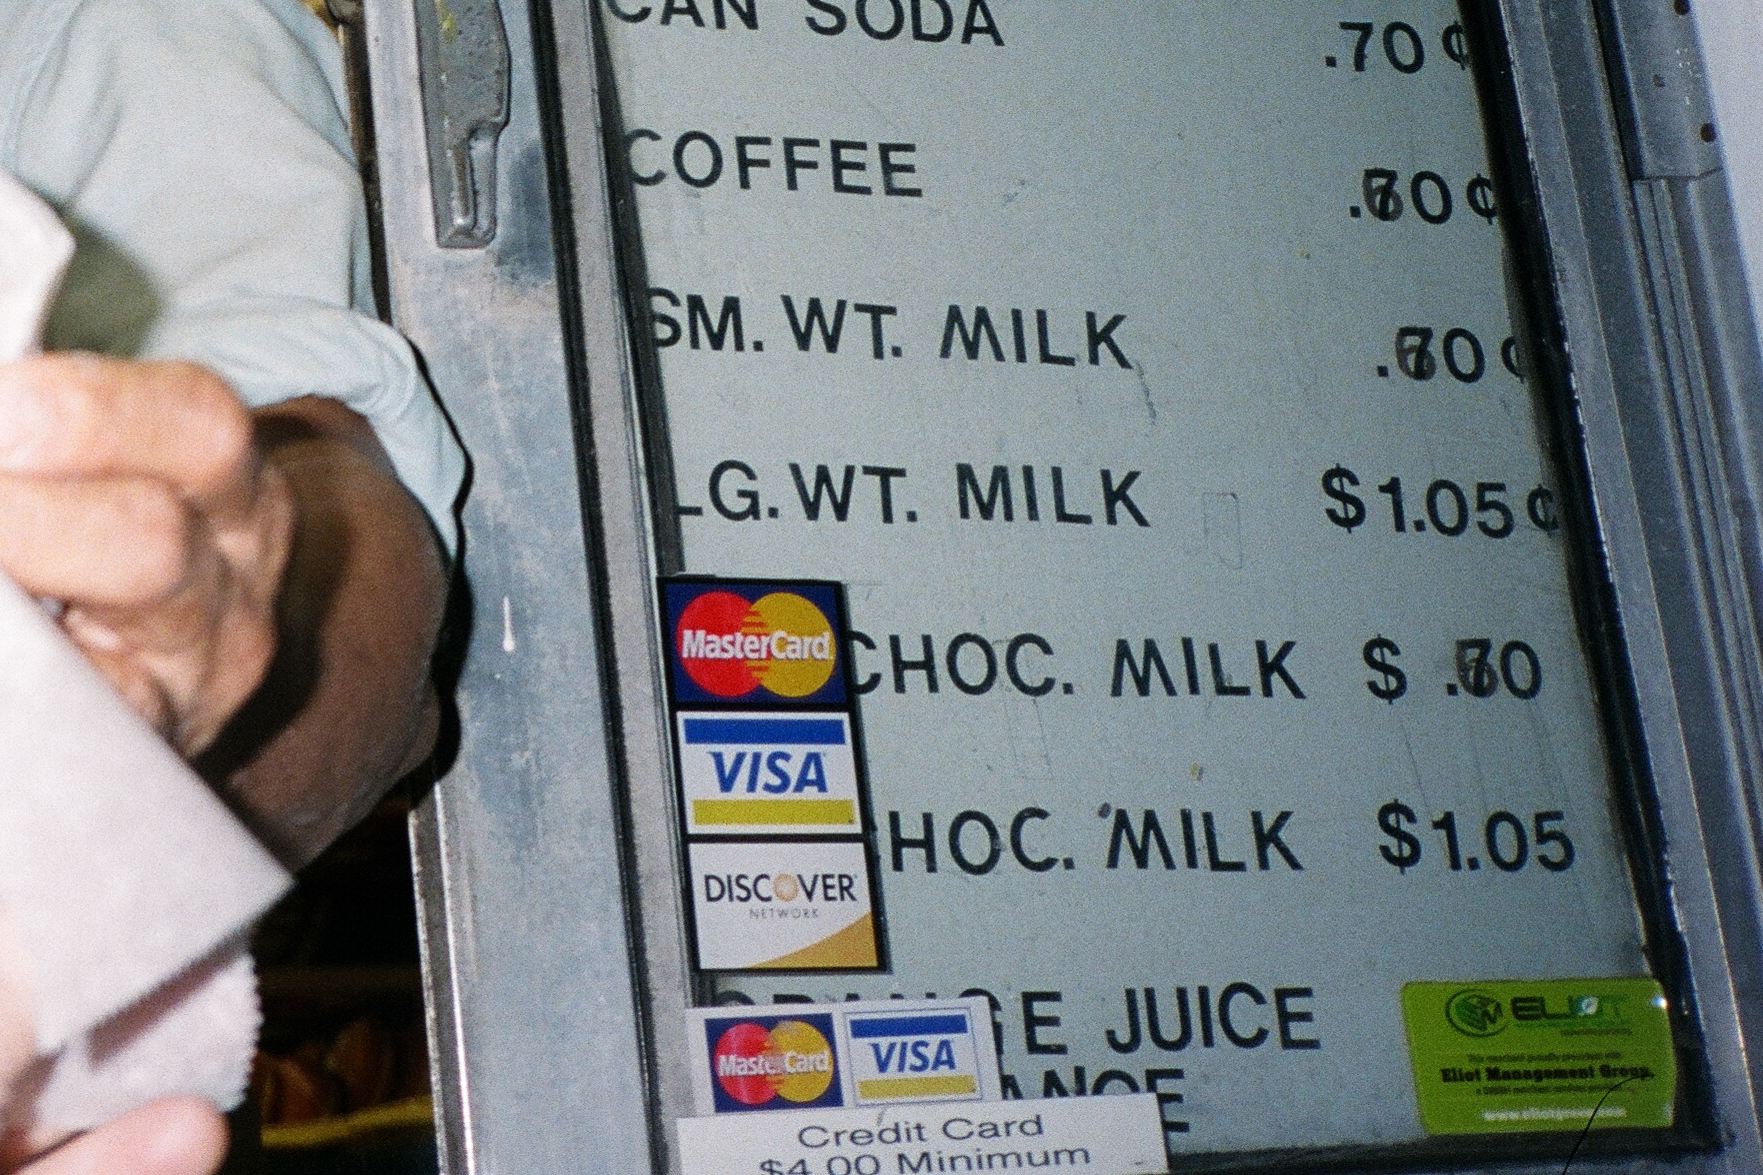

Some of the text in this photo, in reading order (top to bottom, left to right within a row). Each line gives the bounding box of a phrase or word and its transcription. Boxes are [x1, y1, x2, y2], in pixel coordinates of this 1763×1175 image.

[624, 128, 924, 198] COFFEE
[940, 304, 1134, 370] MILK
[956, 463, 1152, 528] MILK
[681, 629, 830, 661] MasterCard
[1110, 637, 1307, 700] MILK
[706, 750, 828, 794] VISA
[886, 798, 1575, 875] HOC. MILK $1.05
[704, 873, 858, 903] DISCOVER
[749, 907, 819, 920] NETWORK
[1105, 982, 1321, 1054] JUICE
[869, 1039, 957, 1074] VISA
[797, 1114, 1044, 1149] Credit Card
[897, 1144, 1090, 1175] Minimum
